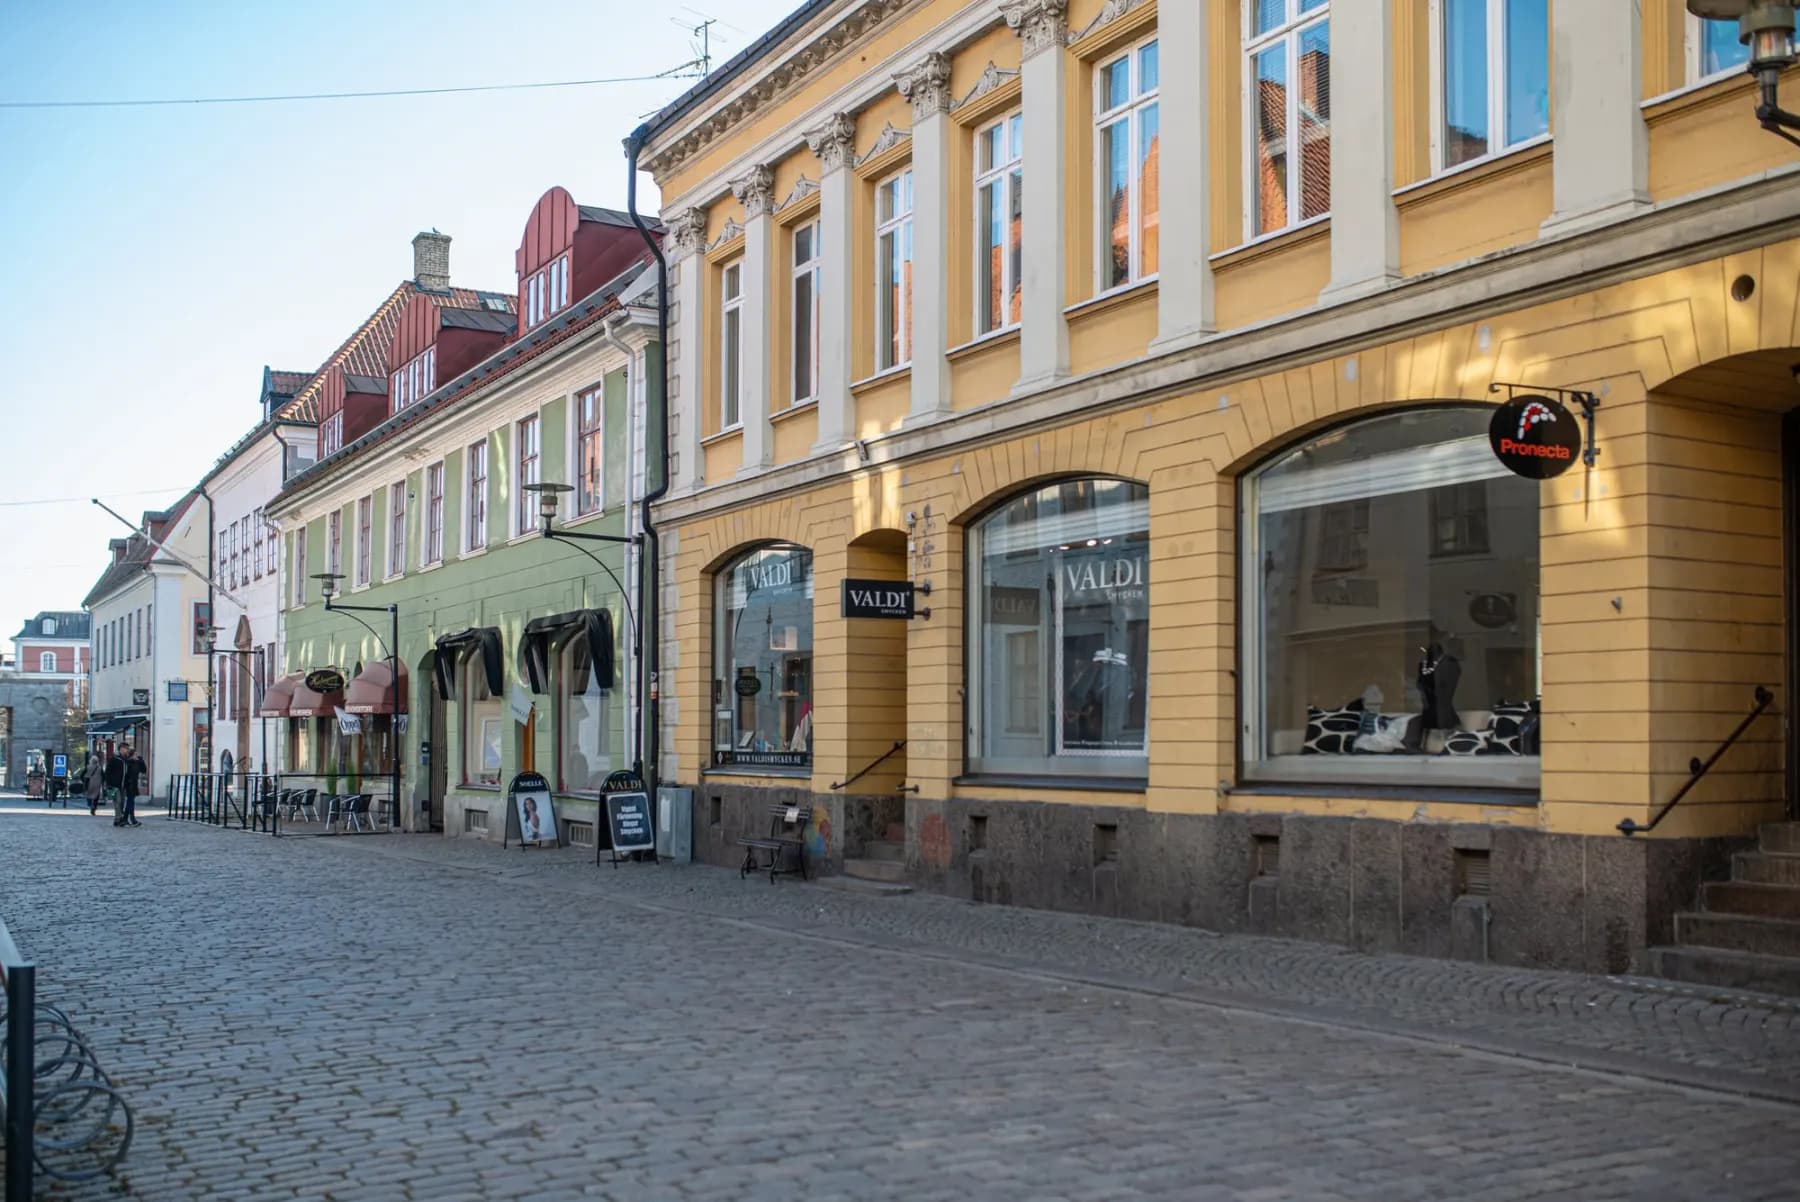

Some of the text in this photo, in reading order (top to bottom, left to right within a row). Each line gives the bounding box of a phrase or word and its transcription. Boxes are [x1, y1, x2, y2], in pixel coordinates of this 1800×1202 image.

[1501, 438, 1570, 459] Pronecta
[751, 561, 792, 589] VALDI
[1067, 557, 1144, 591] VALDI
[608, 780, 642, 791] VALDI
